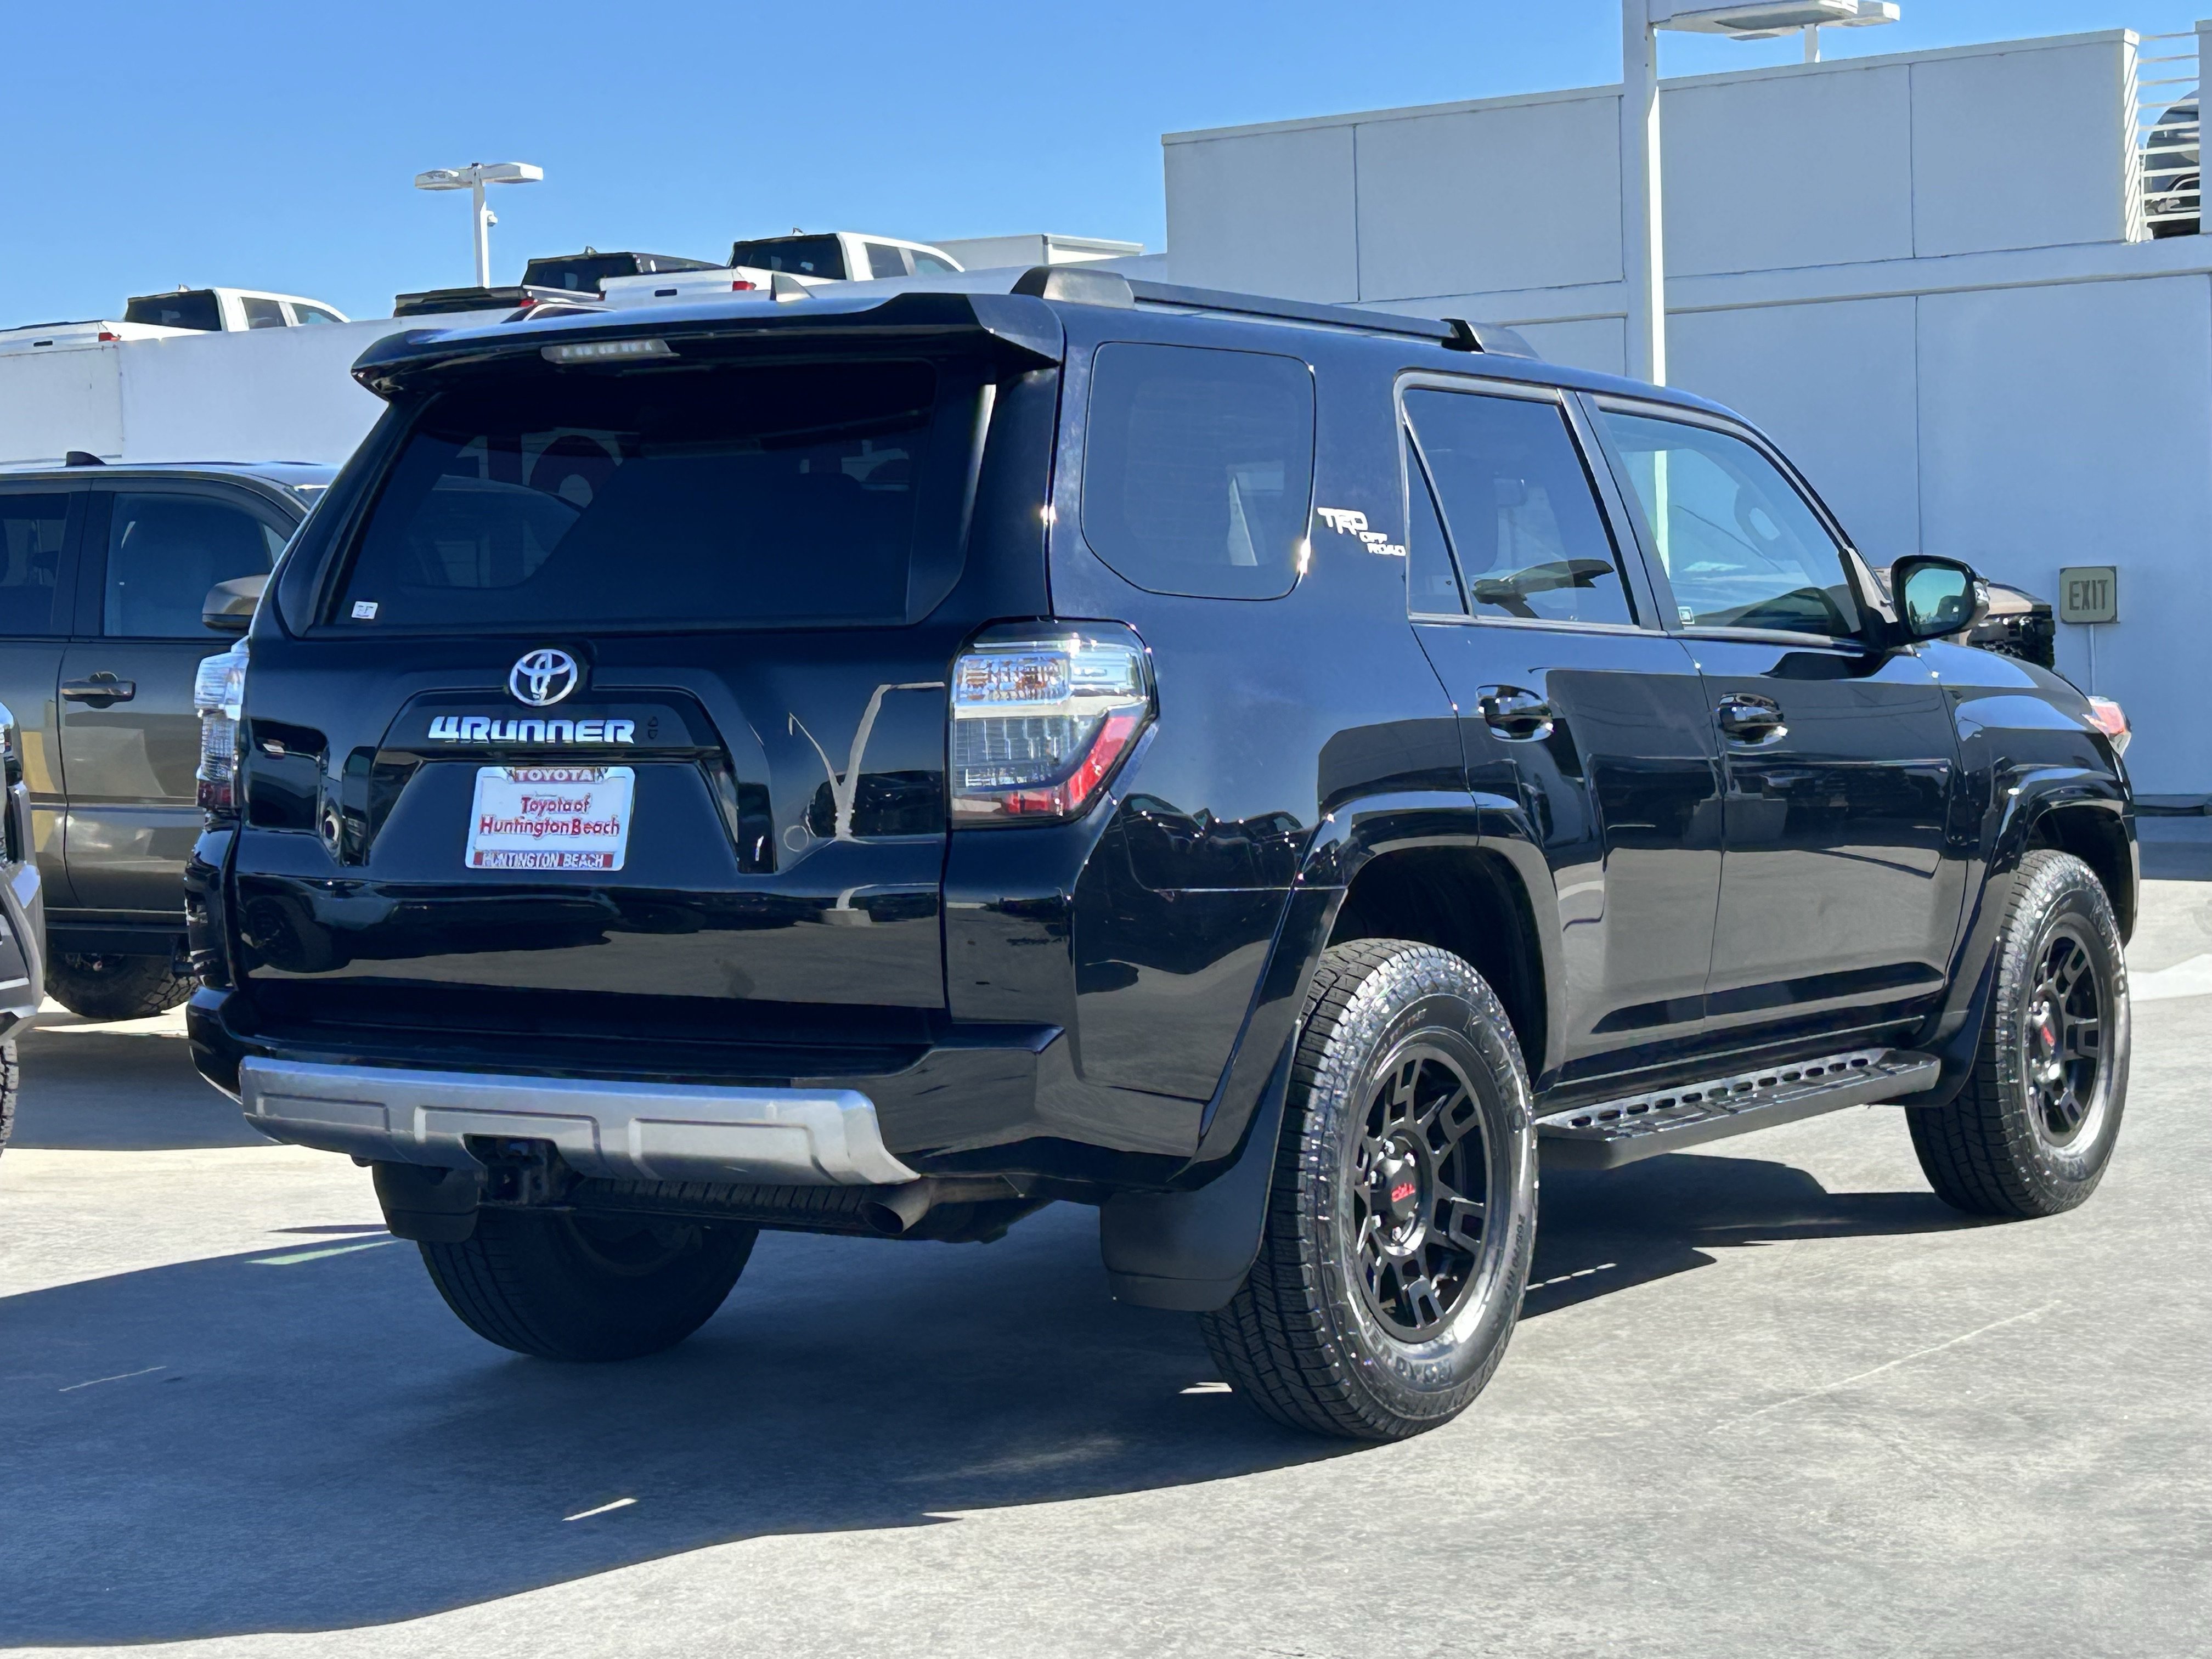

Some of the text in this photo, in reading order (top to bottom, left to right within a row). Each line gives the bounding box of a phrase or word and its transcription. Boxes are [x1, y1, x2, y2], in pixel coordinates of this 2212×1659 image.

[1317, 507, 1368, 534] TRD
[2069, 579, 2108, 610] EXIT
[428, 716, 635, 744] 4RUNNER
[516, 769, 592, 781] TOYOTA
[521, 793, 590, 817] Toyota of
[479, 816, 620, 838] Huntington Beach
[482, 852, 604, 868] HUNTINGTON BEACH
